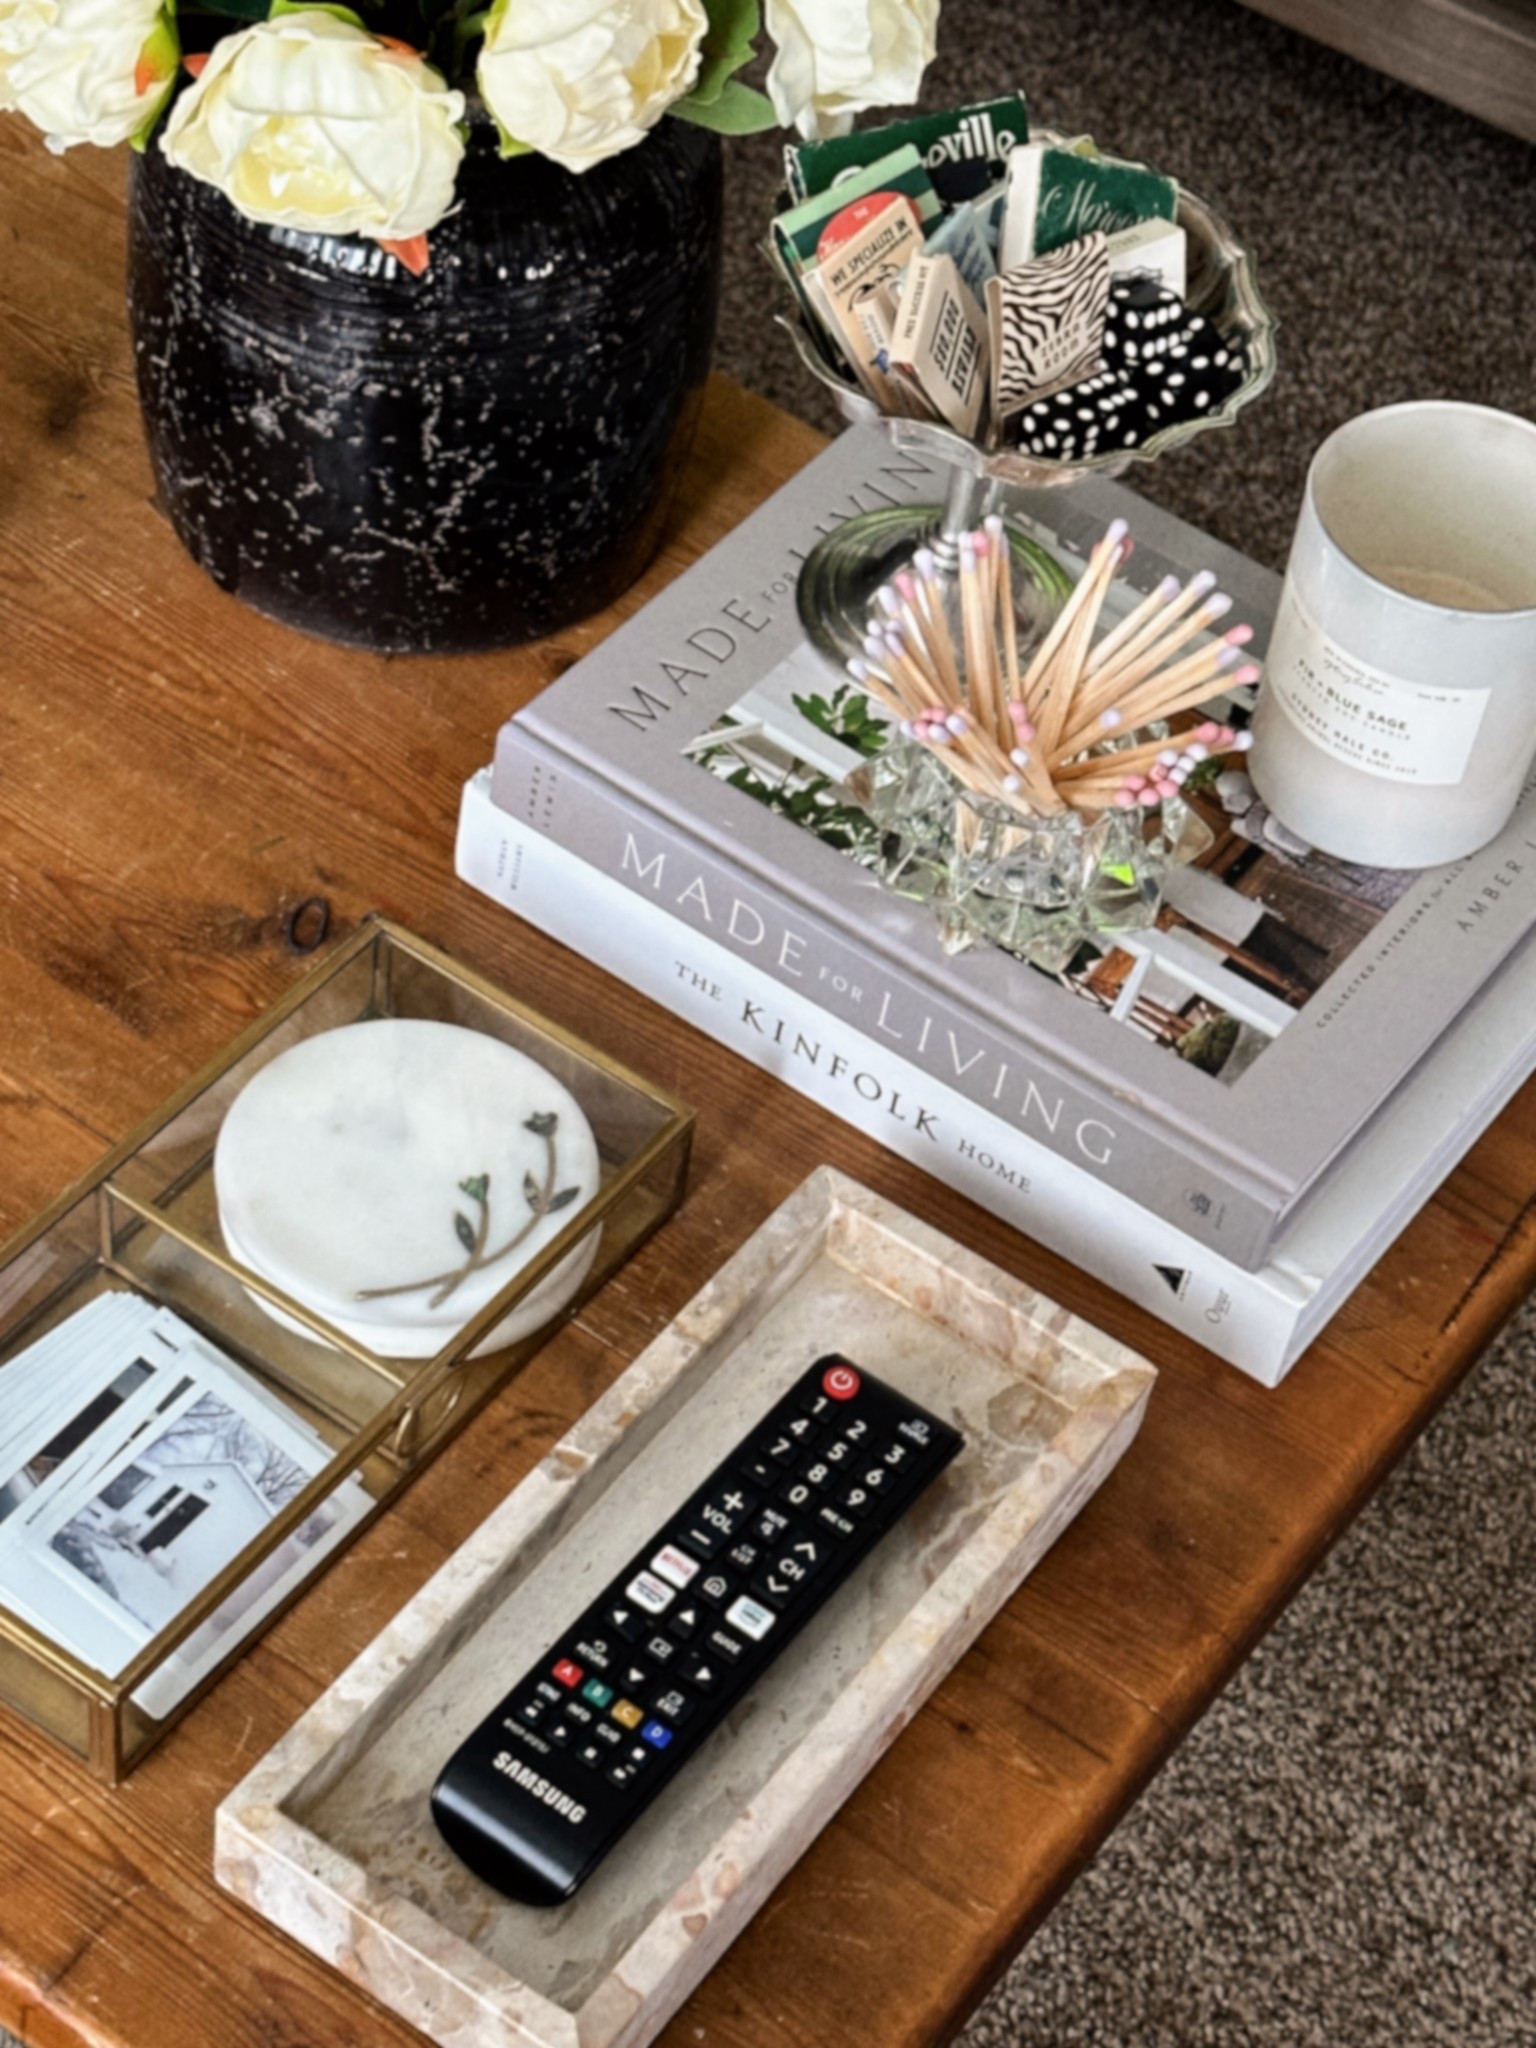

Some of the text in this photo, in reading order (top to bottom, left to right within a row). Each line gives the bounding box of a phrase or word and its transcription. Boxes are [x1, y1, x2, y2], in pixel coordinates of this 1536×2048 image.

[607, 598, 771, 732] MADE
[761, 571, 797, 603] FOR
[1327, 687, 1360, 713] BLUE
[1367, 710, 1407, 731] SAGE
[1456, 859, 1524, 933] AMBER
[1316, 964, 1376, 1029] COLLECTED
[1376, 902, 1432, 961] INTERIORS
[621, 832, 1117, 1165] MADE FOR LIVING
[674, 960, 1033, 1195] THE KINFOLK HOME
[812, 1396, 828, 1414] 1
[790, 1418, 809, 1436] 4
[846, 1420, 867, 1440] 2
[770, 1437, 791, 1455] 7
[827, 1441, 848, 1461] 5
[884, 1444, 905, 1464] 3
[807, 1463, 829, 1483] 8
[865, 1468, 885, 1486] 6
[847, 1488, 866, 1506] 9
[702, 1504, 733, 1534] VOL
[763, 1508, 789, 1529] MUTE
[779, 1558, 806, 1581] CH
[711, 1630, 742, 1655] GUIDE
[576, 1641, 610, 1668] RETURN
[562, 1665, 574, 1677] A
[592, 1684, 605, 1698] B
[566, 1702, 592, 1723] INFO
[622, 1707, 634, 1719] C
[656, 1697, 680, 1717] EXIT
[651, 1725, 664, 1739] D
[492, 1751, 588, 1824] SAMSUNG
